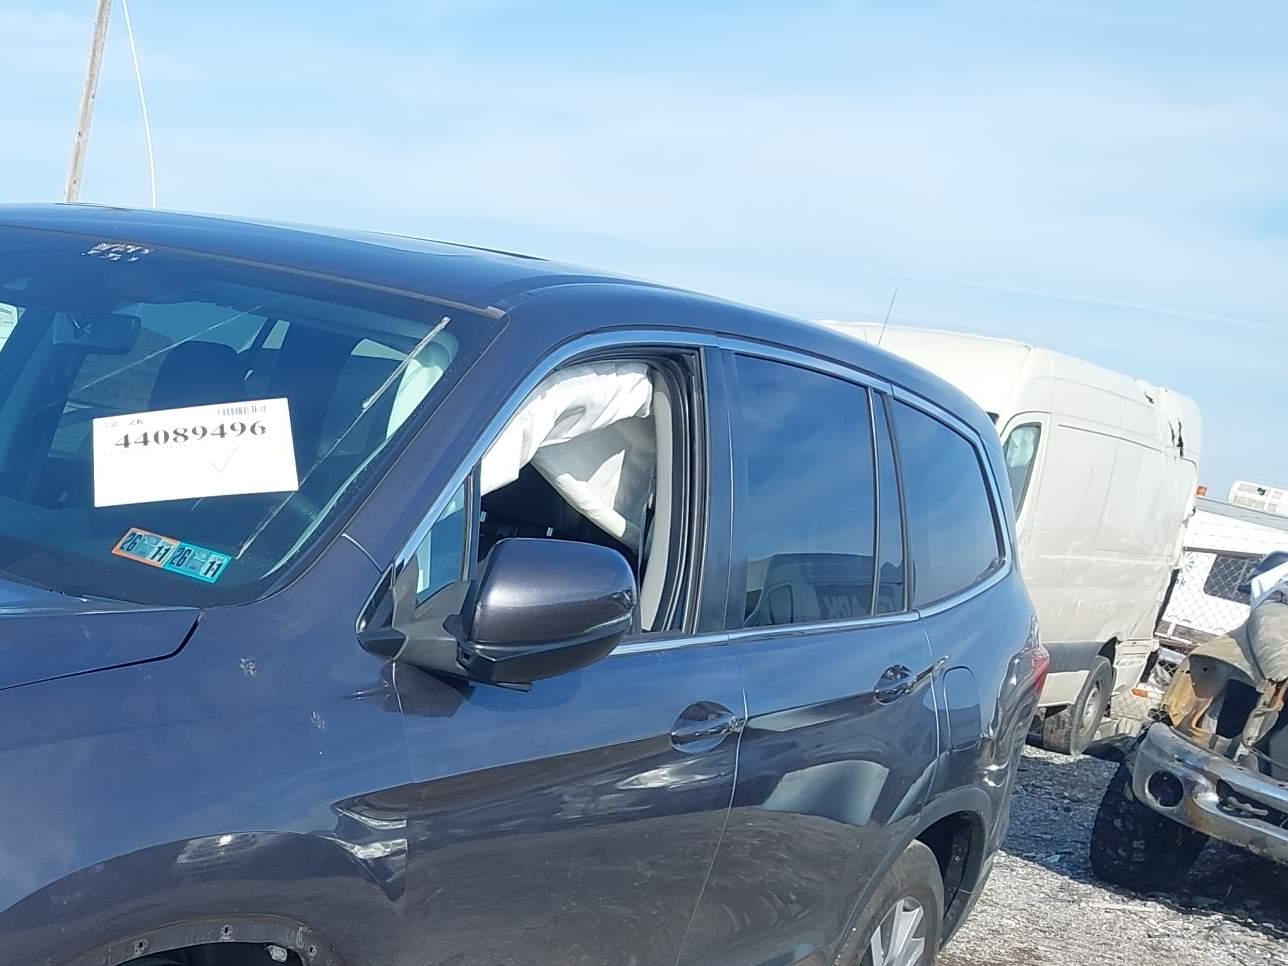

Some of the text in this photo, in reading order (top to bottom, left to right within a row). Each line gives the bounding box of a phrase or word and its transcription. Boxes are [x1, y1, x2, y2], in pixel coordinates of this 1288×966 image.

[115, 421, 267, 448] 44089496
[120, 532, 172, 563] 26 11
[171, 547, 224, 578] 26 11
